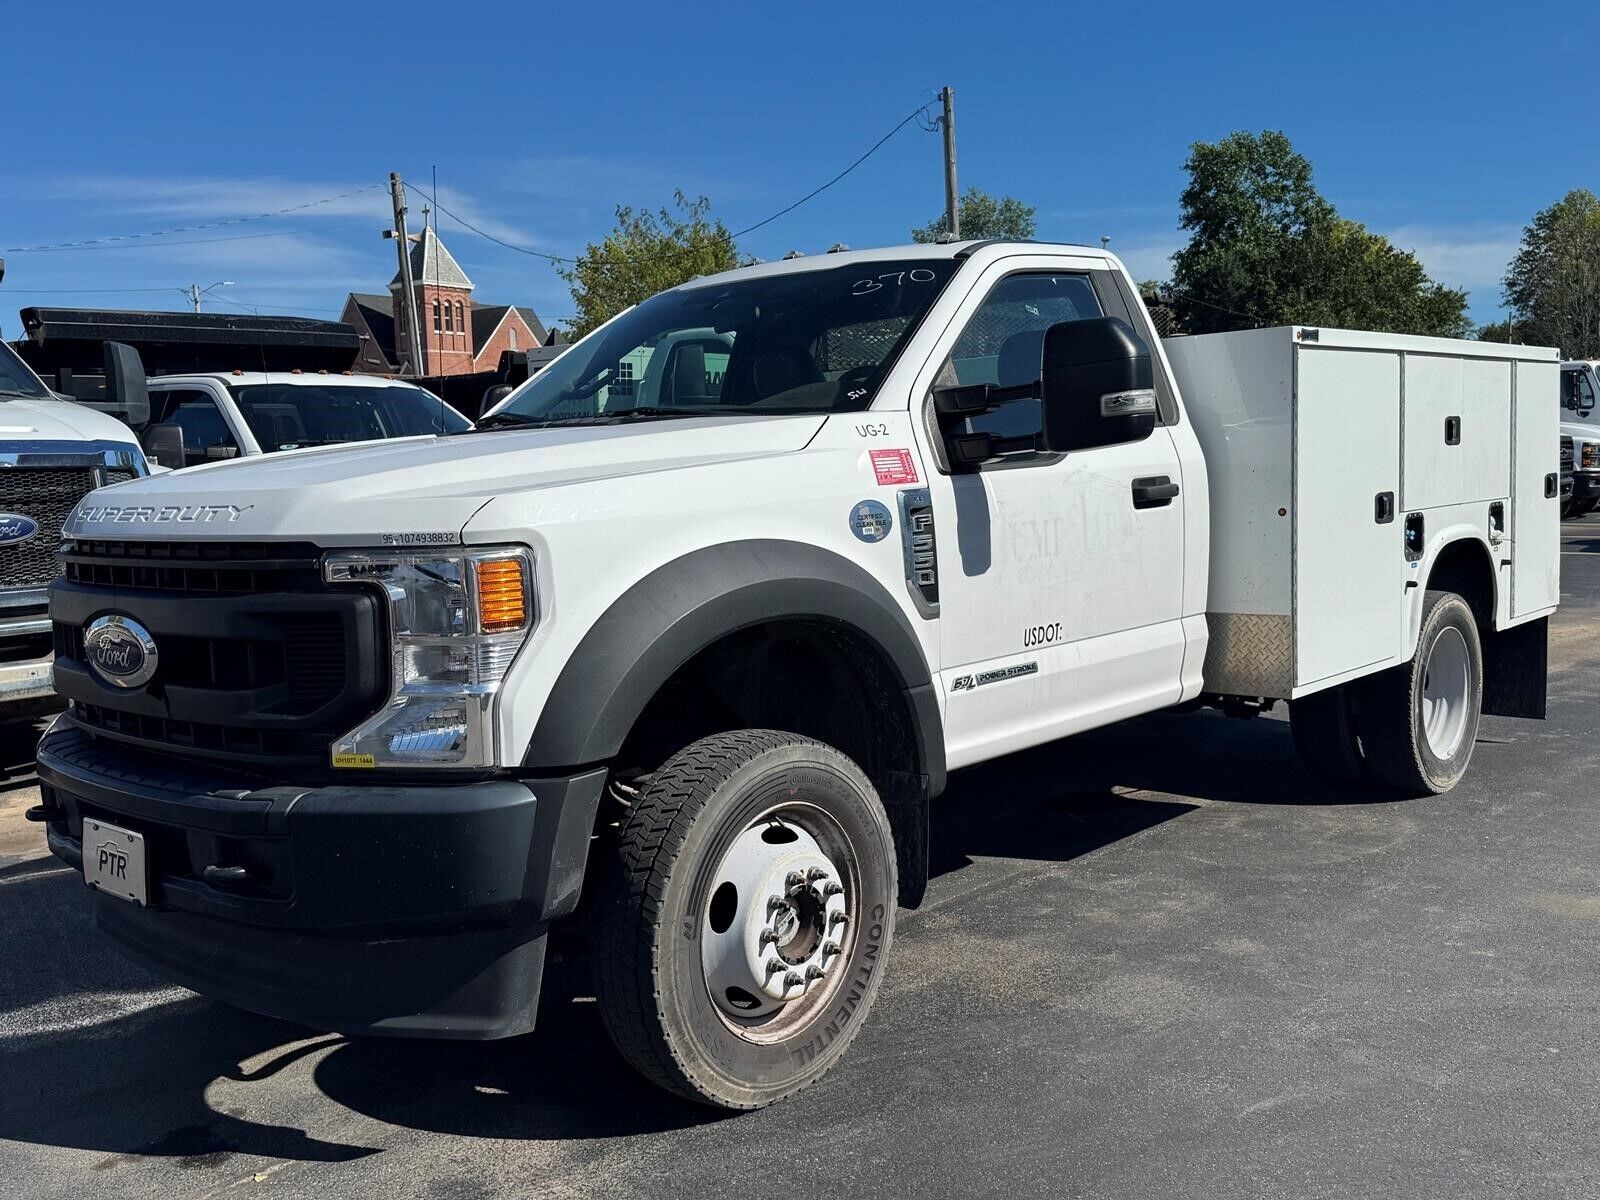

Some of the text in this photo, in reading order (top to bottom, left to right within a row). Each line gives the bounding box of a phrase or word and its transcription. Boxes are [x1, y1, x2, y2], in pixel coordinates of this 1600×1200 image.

[852, 268, 936, 295] 370
[855, 423, 890, 439] UG-2
[77, 505, 254, 522] SUPER DUTY
[856, 520, 873, 528] CLEAN
[912, 513, 936, 585] F550
[1023, 622, 1063, 647] USDOT:
[96, 635, 130, 668] Ford
[979, 669, 1006, 682] POWER
[1006, 662, 1037, 675] STROKE
[99, 849, 127, 880] PTR
[791, 903, 885, 1066] CONTINENTAL
